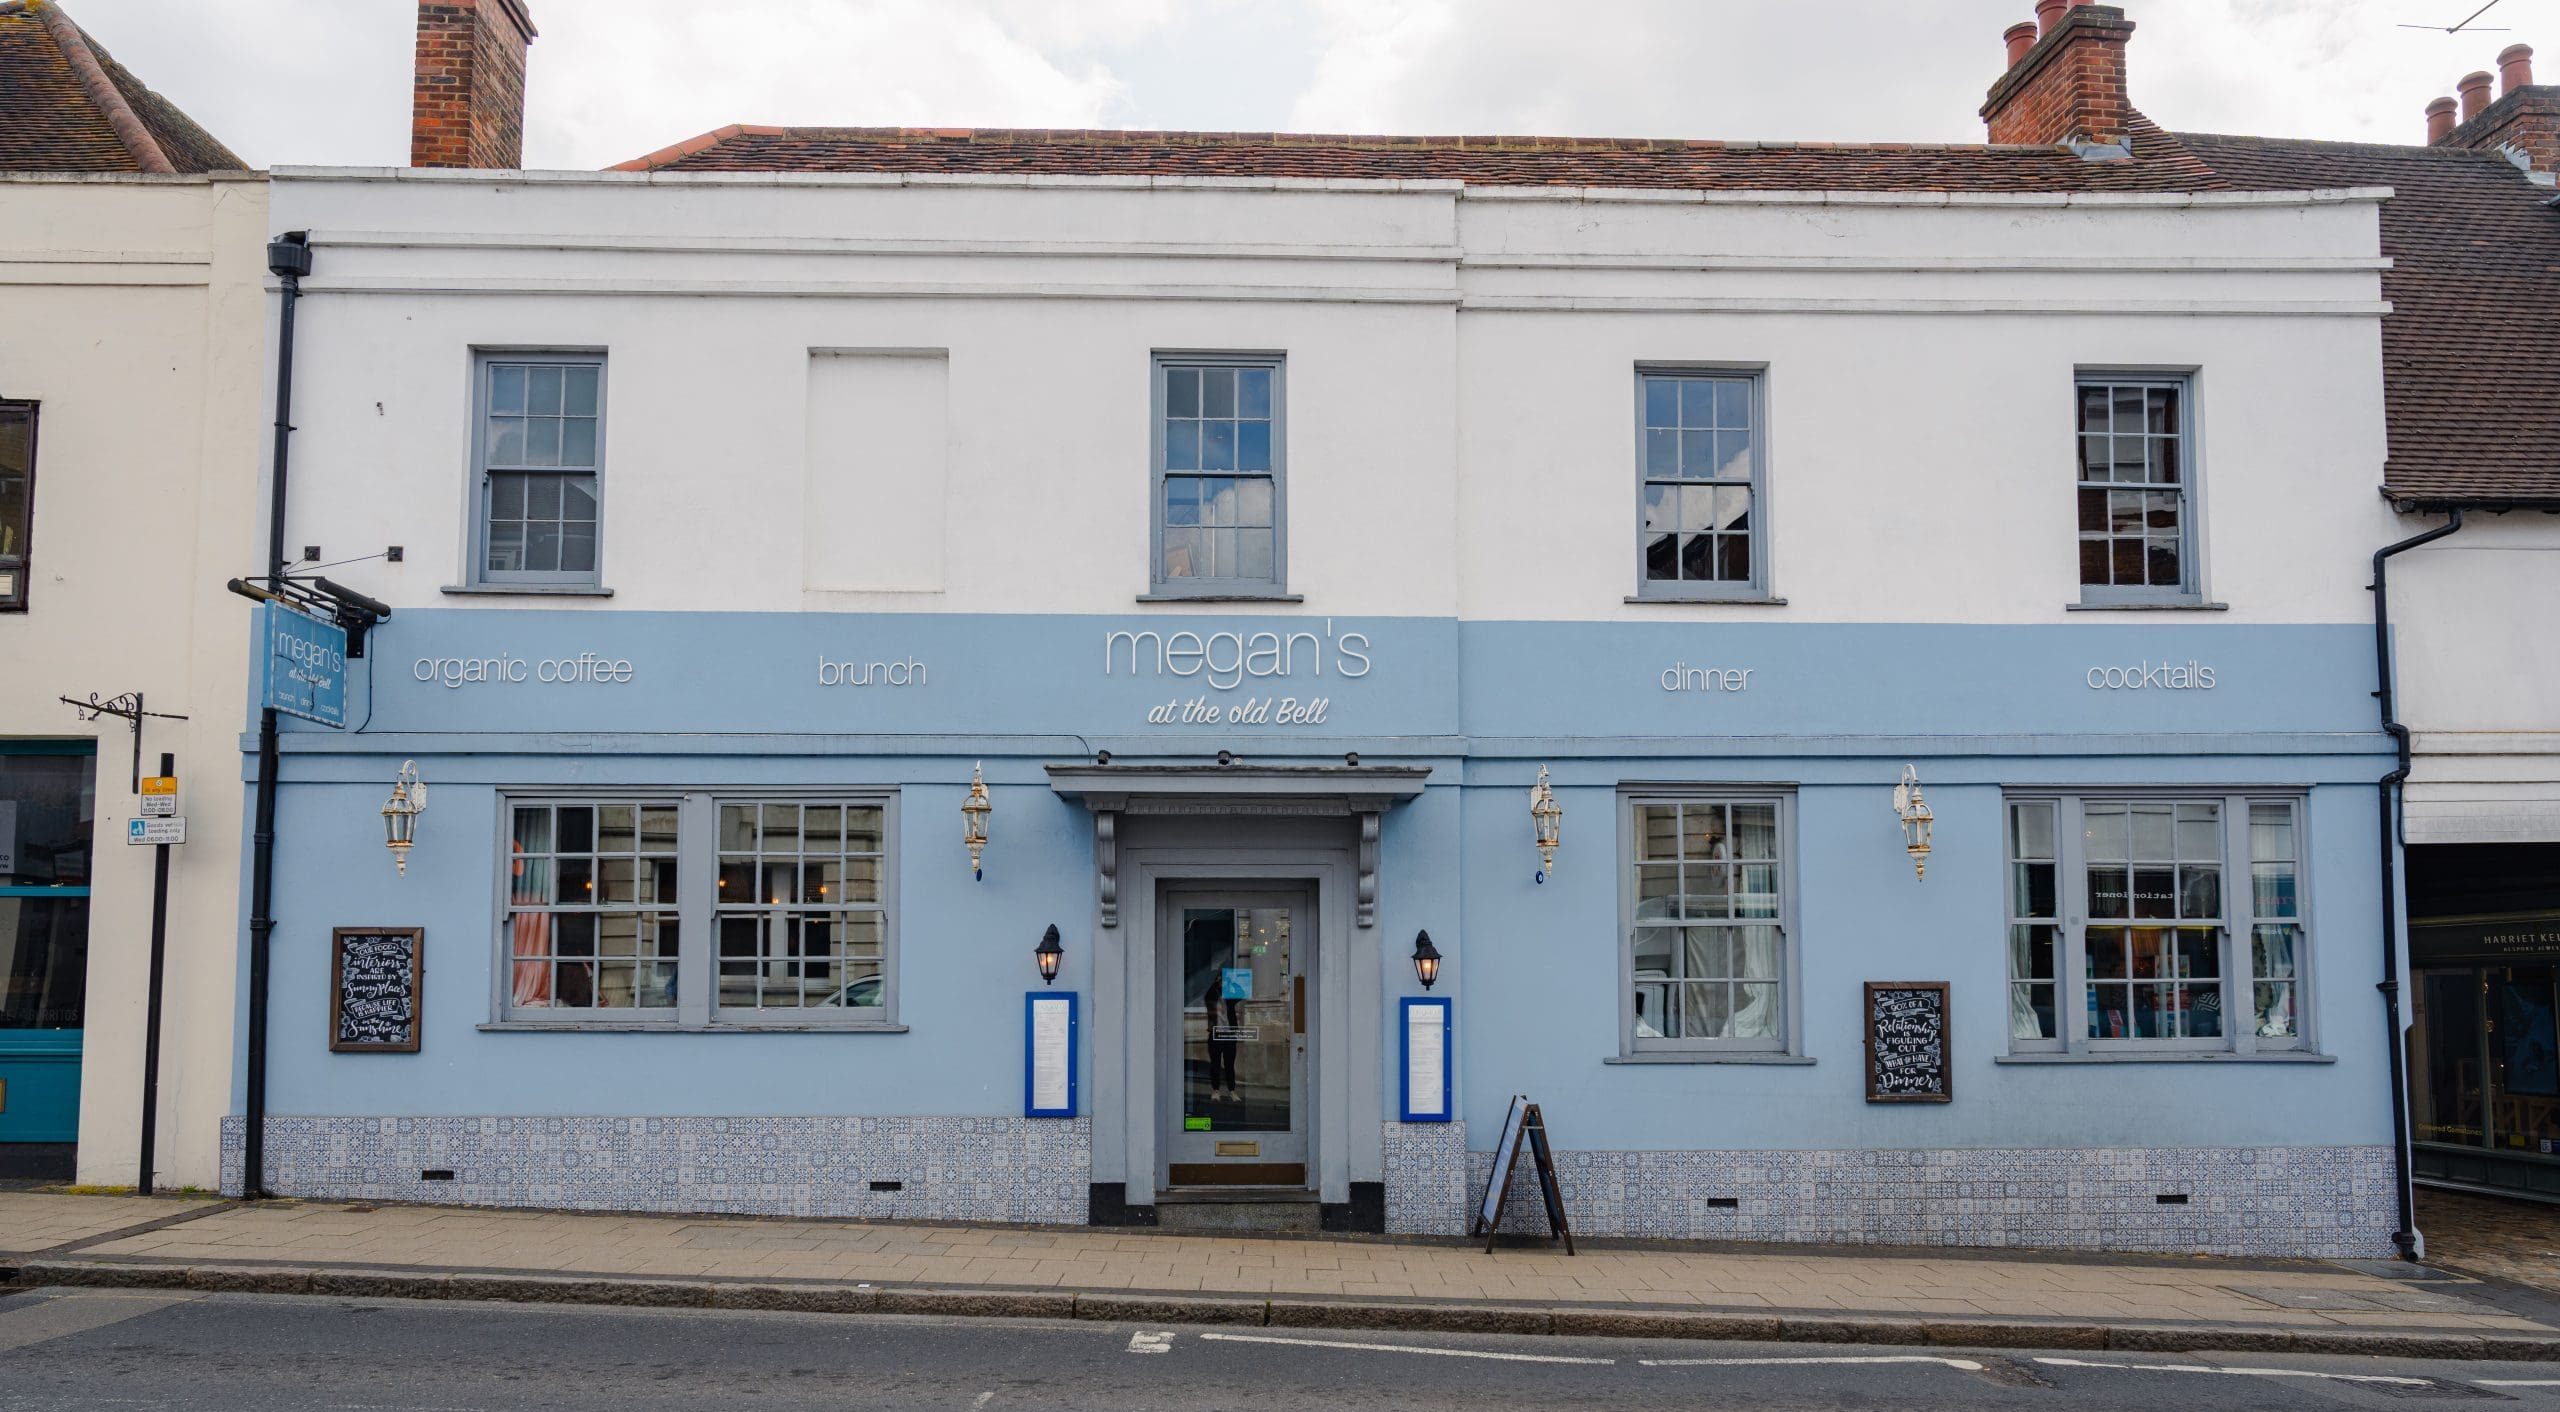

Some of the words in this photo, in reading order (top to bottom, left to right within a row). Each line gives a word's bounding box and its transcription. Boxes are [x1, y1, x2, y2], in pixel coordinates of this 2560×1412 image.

[280, 631, 341, 673] megan's
[1107, 618, 1369, 689] megan's
[415, 652, 526, 687] organic
[538, 653, 632, 681] coffee
[820, 656, 925, 684] brunch
[1662, 662, 1753, 690] dinner
[2087, 660, 2215, 688] cocktails
[1149, 699, 1177, 722] at
[1183, 696, 1220, 723] the
[1229, 698, 1271, 723] old
[1276, 698, 1328, 723] Bell
[2484, 934, 2535, 944] HARRIET
[351, 955, 405, 968] interiors
[1876, 1016, 1937, 1042] Relationship
[1886, 1037, 1928, 1045] FIGURING
[1884, 1057, 1904, 1068] WHAT
[1912, 1053, 1930, 1063] HAVE
[1898, 1044, 1917, 1053] OUT
[1878, 1072, 1935, 1089] Dinner
[1900, 1067, 1916, 1075] FOR
